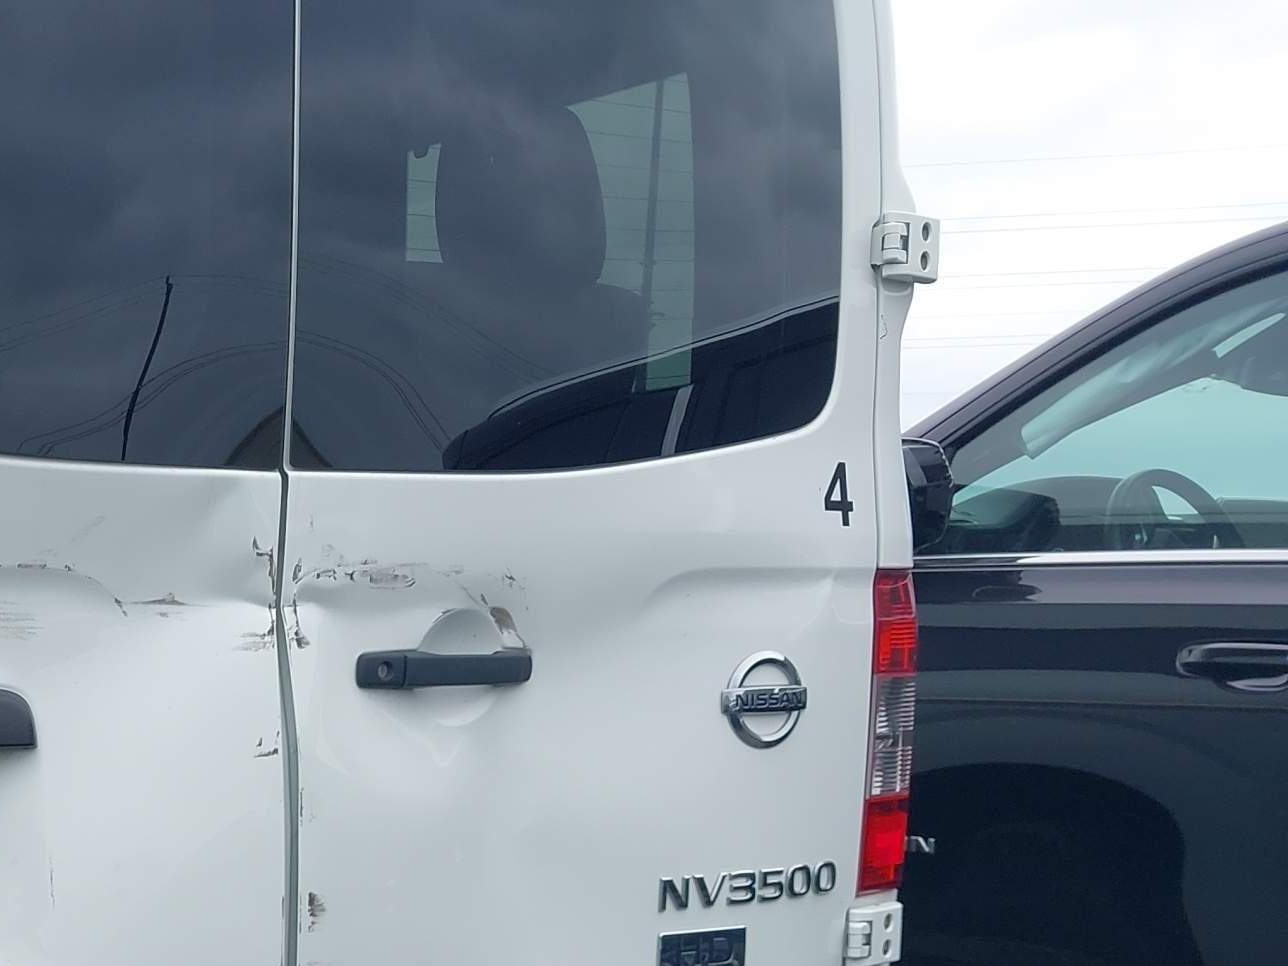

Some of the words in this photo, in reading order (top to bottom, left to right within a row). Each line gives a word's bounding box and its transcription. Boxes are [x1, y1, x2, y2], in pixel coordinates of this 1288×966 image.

[824, 461, 854, 527] 4
[731, 693, 804, 711] NISSAN
[658, 861, 837, 913] NV3500
